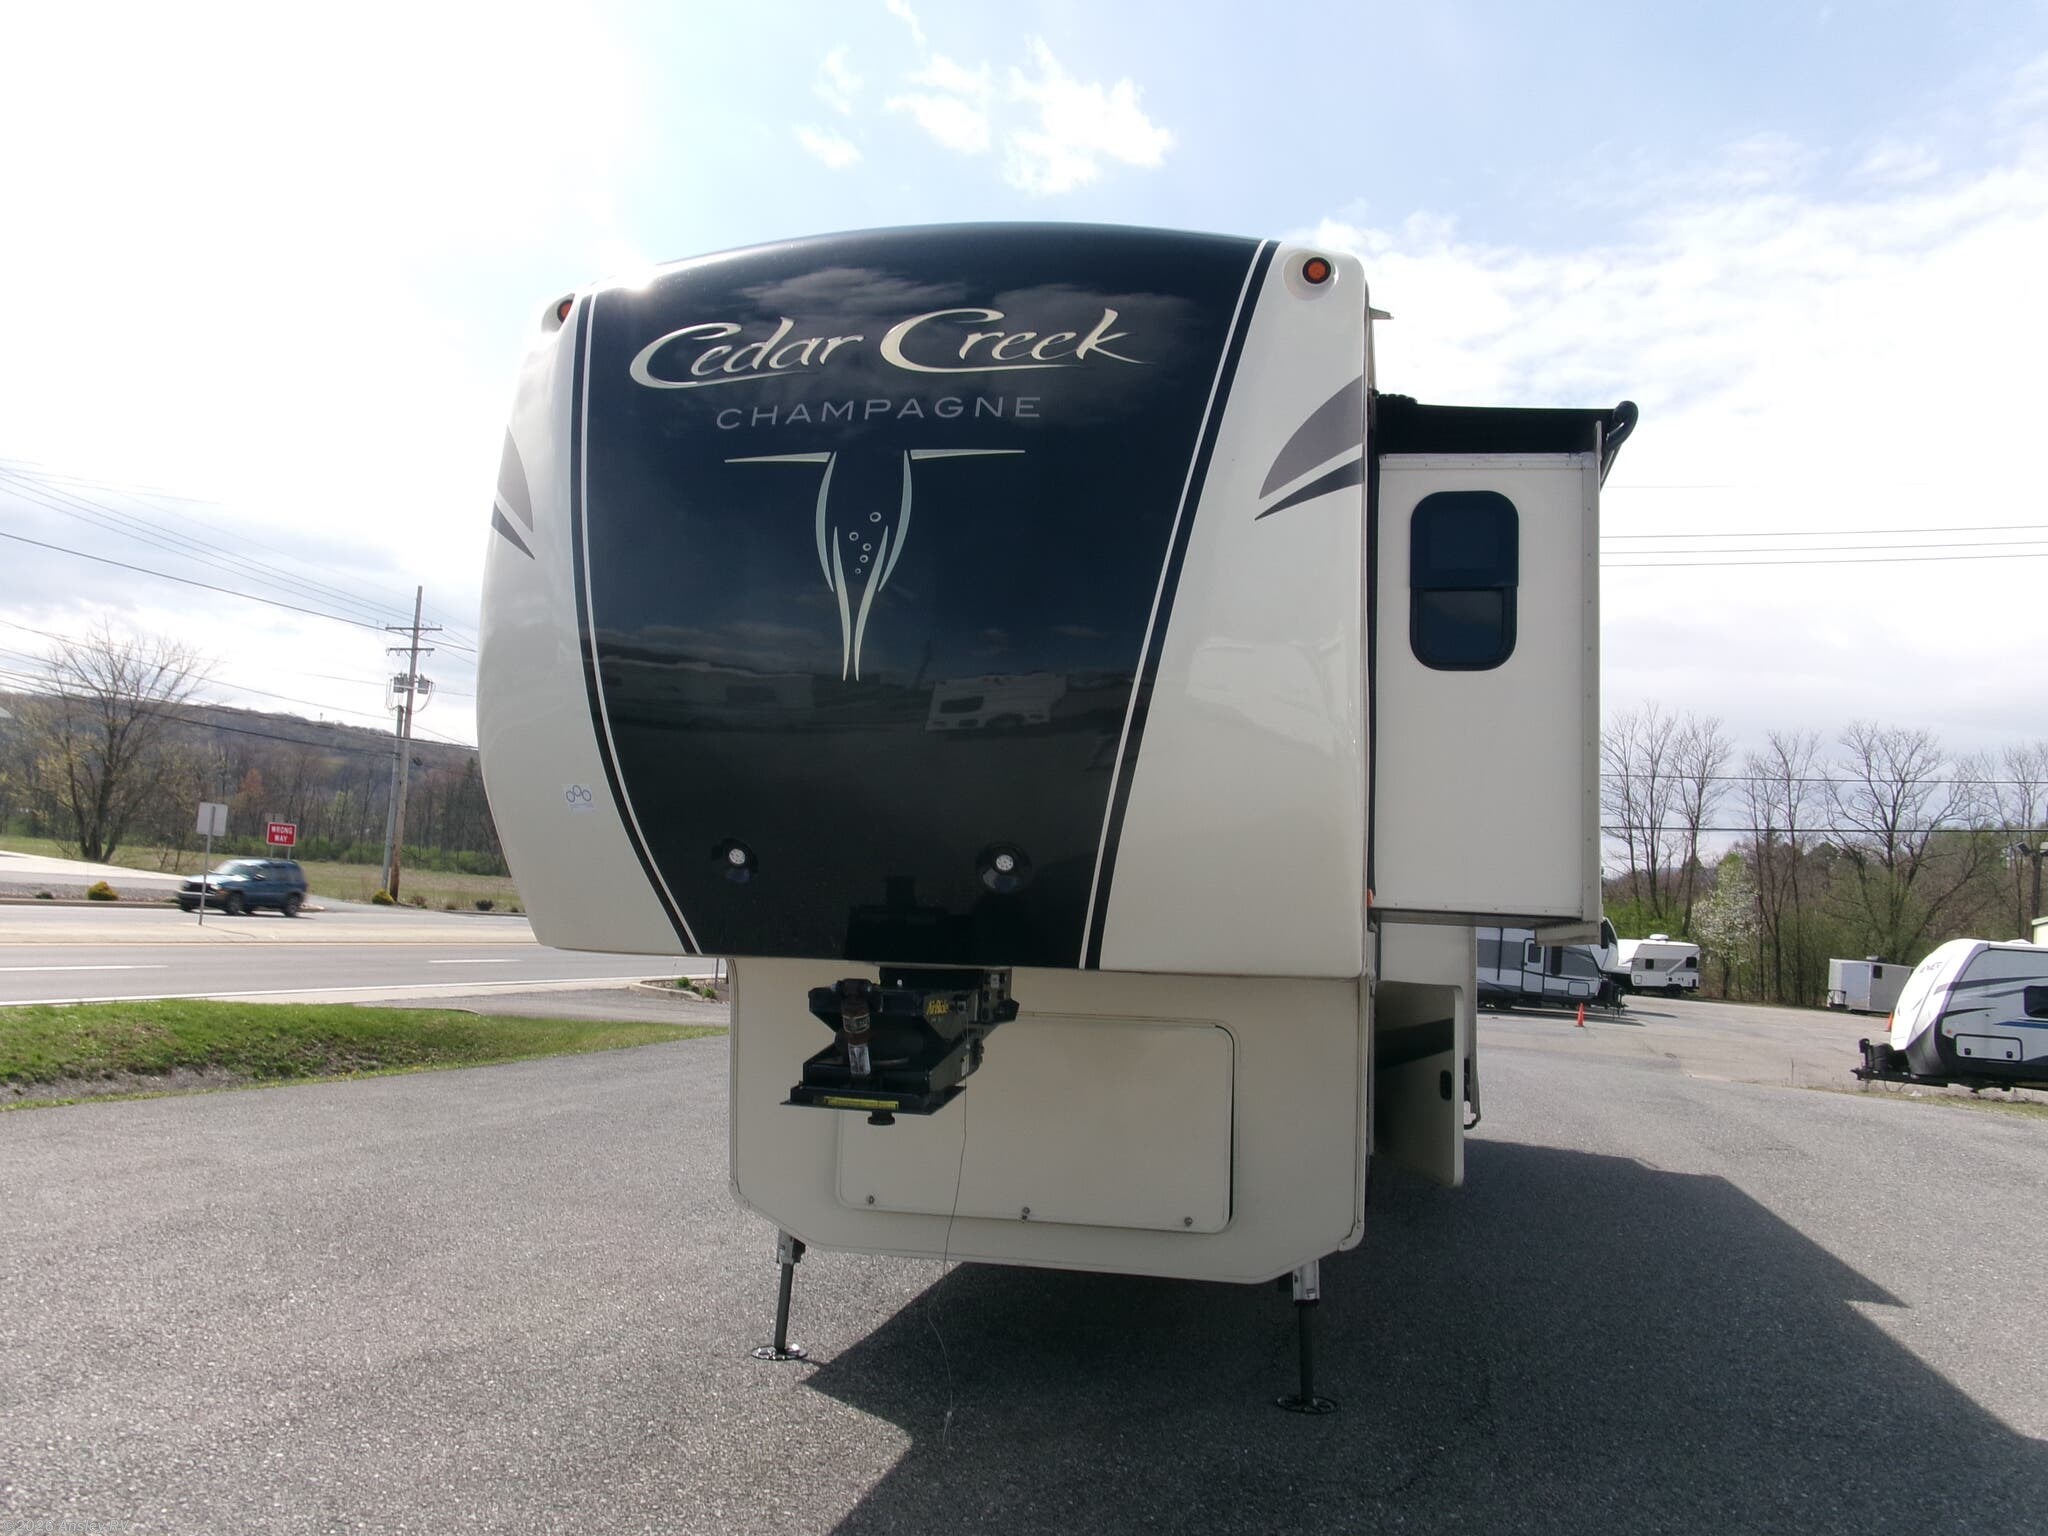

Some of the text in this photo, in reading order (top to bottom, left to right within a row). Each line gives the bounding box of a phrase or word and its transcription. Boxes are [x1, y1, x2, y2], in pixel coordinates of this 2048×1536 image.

[629, 307, 1155, 389] Cedar Creek
[716, 396, 1041, 430] CHAMPAGNE
[271, 826, 293, 834] WRONG
[274, 834, 288, 842] WAY
